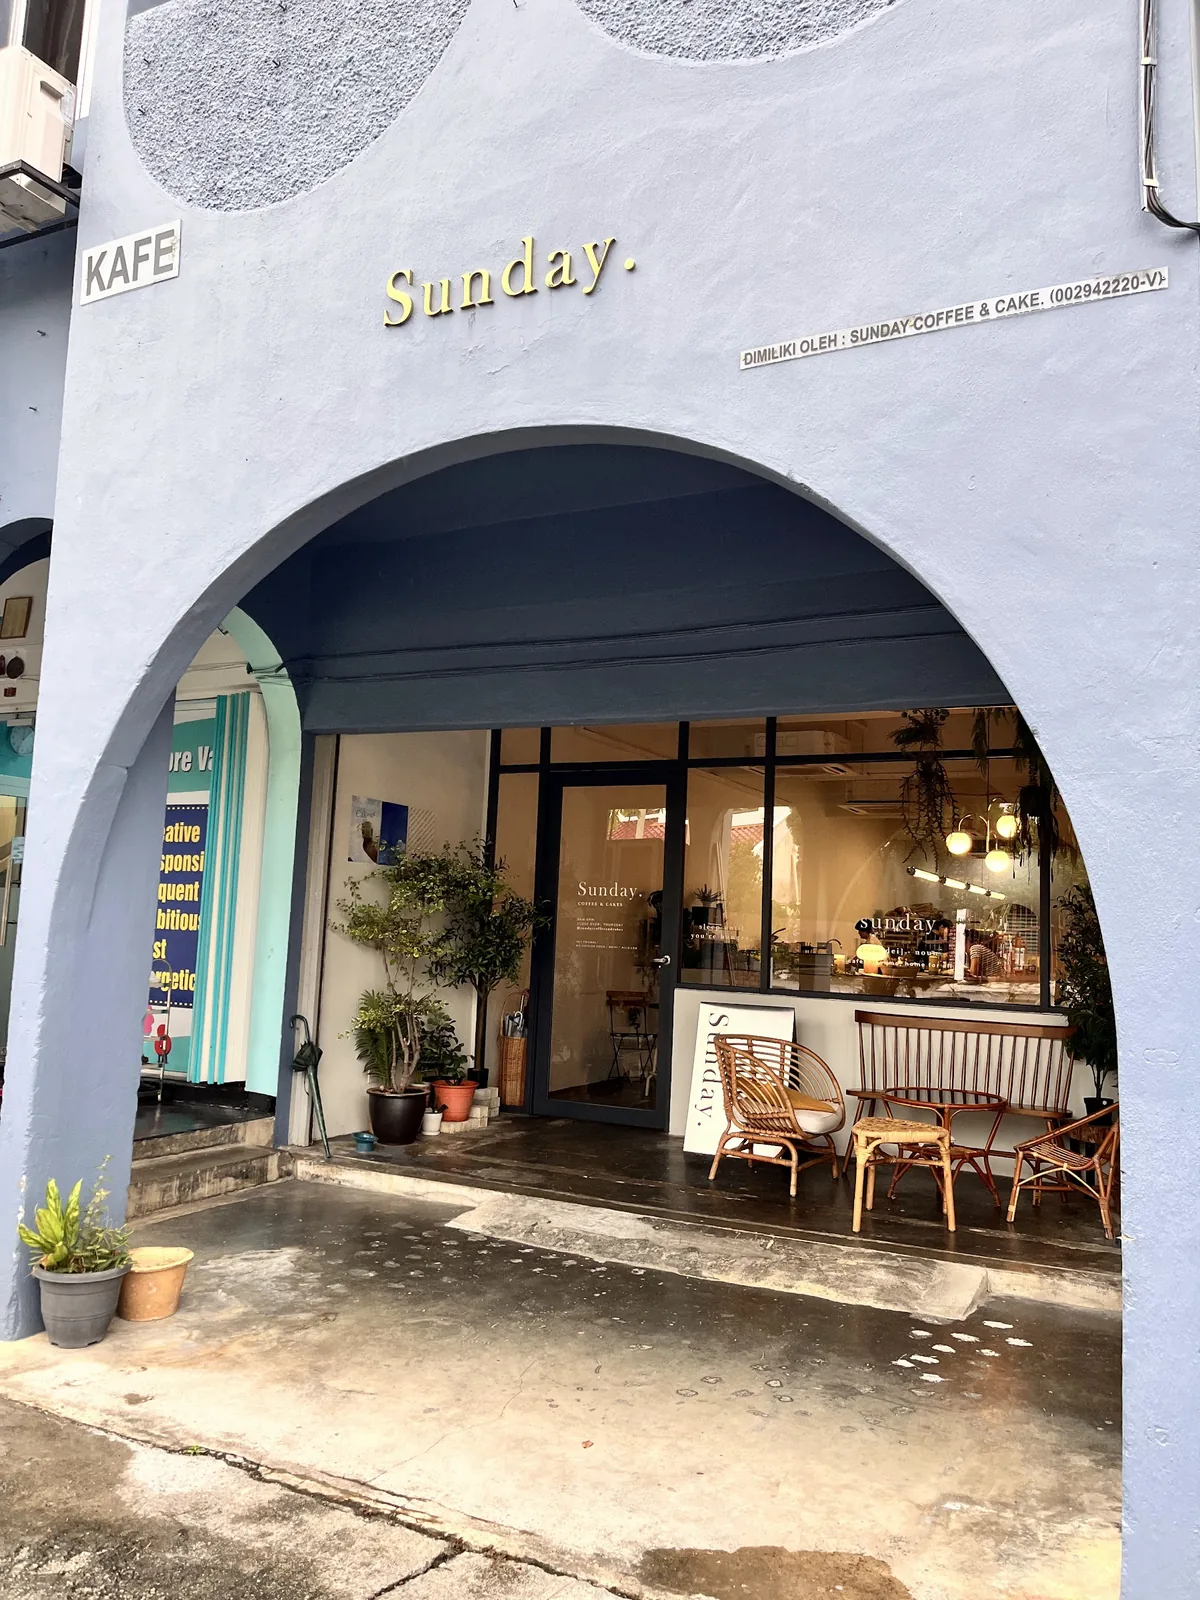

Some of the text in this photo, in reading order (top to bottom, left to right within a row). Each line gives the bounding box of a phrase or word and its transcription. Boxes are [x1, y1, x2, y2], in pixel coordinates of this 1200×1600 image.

[85, 228, 175, 297] KAFE
[382, 236, 637, 327] Sunday.
[743, 342, 797, 367] DIMILIKI
[799, 334, 838, 355] OLEH
[849, 320, 909, 345] SUNDAY
[913, 306, 975, 332] COFFEE
[979, 302, 990, 316] &
[994, 292, 1044, 314] CAKE.
[1049, 271, 1165, 304] (002942220-V)
[163, 822, 201, 843] ative
[158, 882, 200, 903] quent
[577, 881, 643, 901] Sunday.
[156, 909, 201, 931] bitiou
[860, 912, 937, 935] sunday
